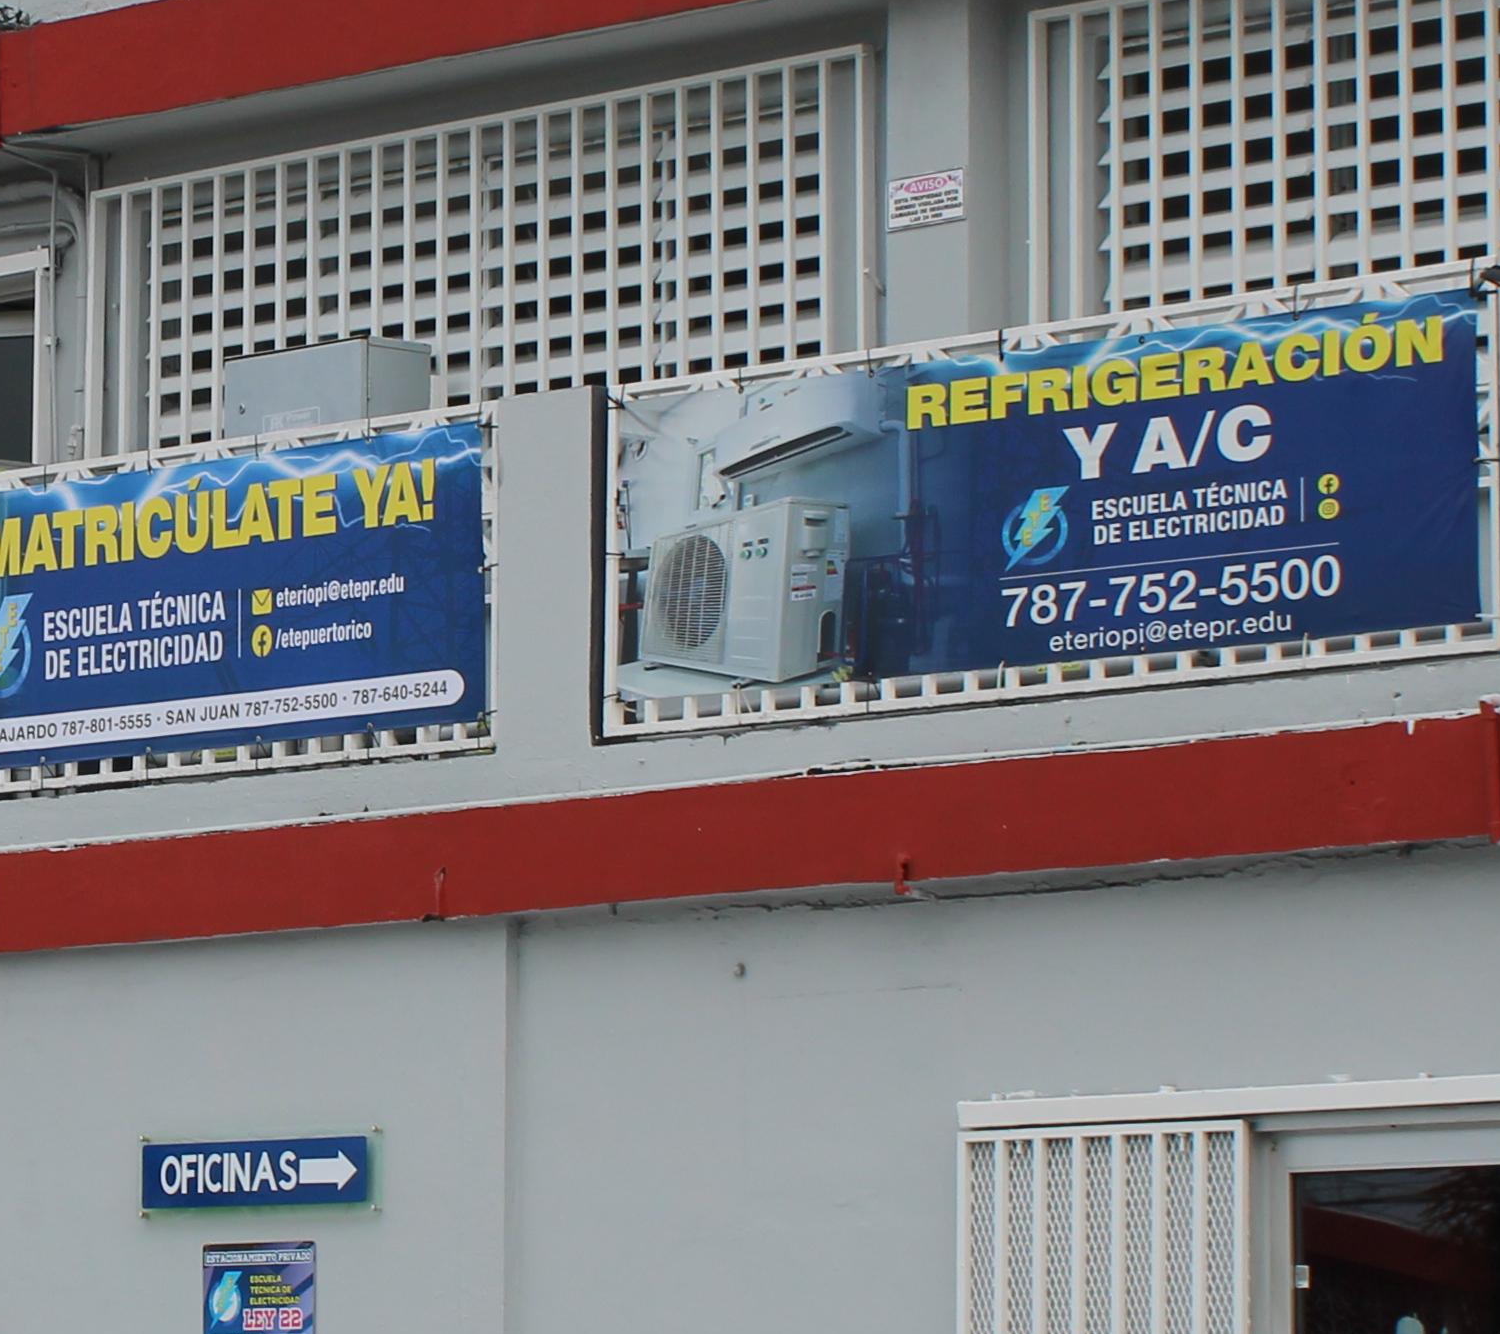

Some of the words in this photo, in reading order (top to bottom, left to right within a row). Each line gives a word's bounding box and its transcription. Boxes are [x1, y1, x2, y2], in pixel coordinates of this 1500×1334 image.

[909, 177, 944, 193] AVISO
[906, 312, 1444, 431] REFRIGERACIÓN
[1063, 422, 1118, 480] Y
[1131, 404, 1273, 475] A/C
[352, 458, 436, 529] YA!
[1091, 490, 1187, 521] ESCUELA
[1193, 478, 1288, 509] TÉCNICA
[1094, 523, 1122, 545] DE
[1128, 505, 1285, 542] ELECTRICIDAD
[275, 572, 405, 608] eteriopi@etepr.edu
[1001, 554, 1341, 628] 787-752-5500
[43, 602, 133, 642] ESCUELA
[138, 590, 226, 630] TÉCNICA
[274, 619, 372, 651] /etepuertorico
[1049, 610, 1292, 653] eteriopi@etepr.edu
[45, 648, 71, 680] DE
[77, 630, 224, 678] ELECTRICIDAD
[61, 713, 153, 737] 787-801-5555
[165, 707, 196, 726] SAN
[199, 702, 240, 722] JUAN
[244, 692, 338, 717] 787-752-5500
[352, 679, 448, 706] 787-640-5244
[160, 1150, 297, 1195] OFICINAS
[249, 1275, 282, 1284] ESCUELA
[249, 1296, 301, 1306] ELECTRICIDAD
[243, 1308, 277, 1331] LEY
[279, 1307, 303, 1330] 22
